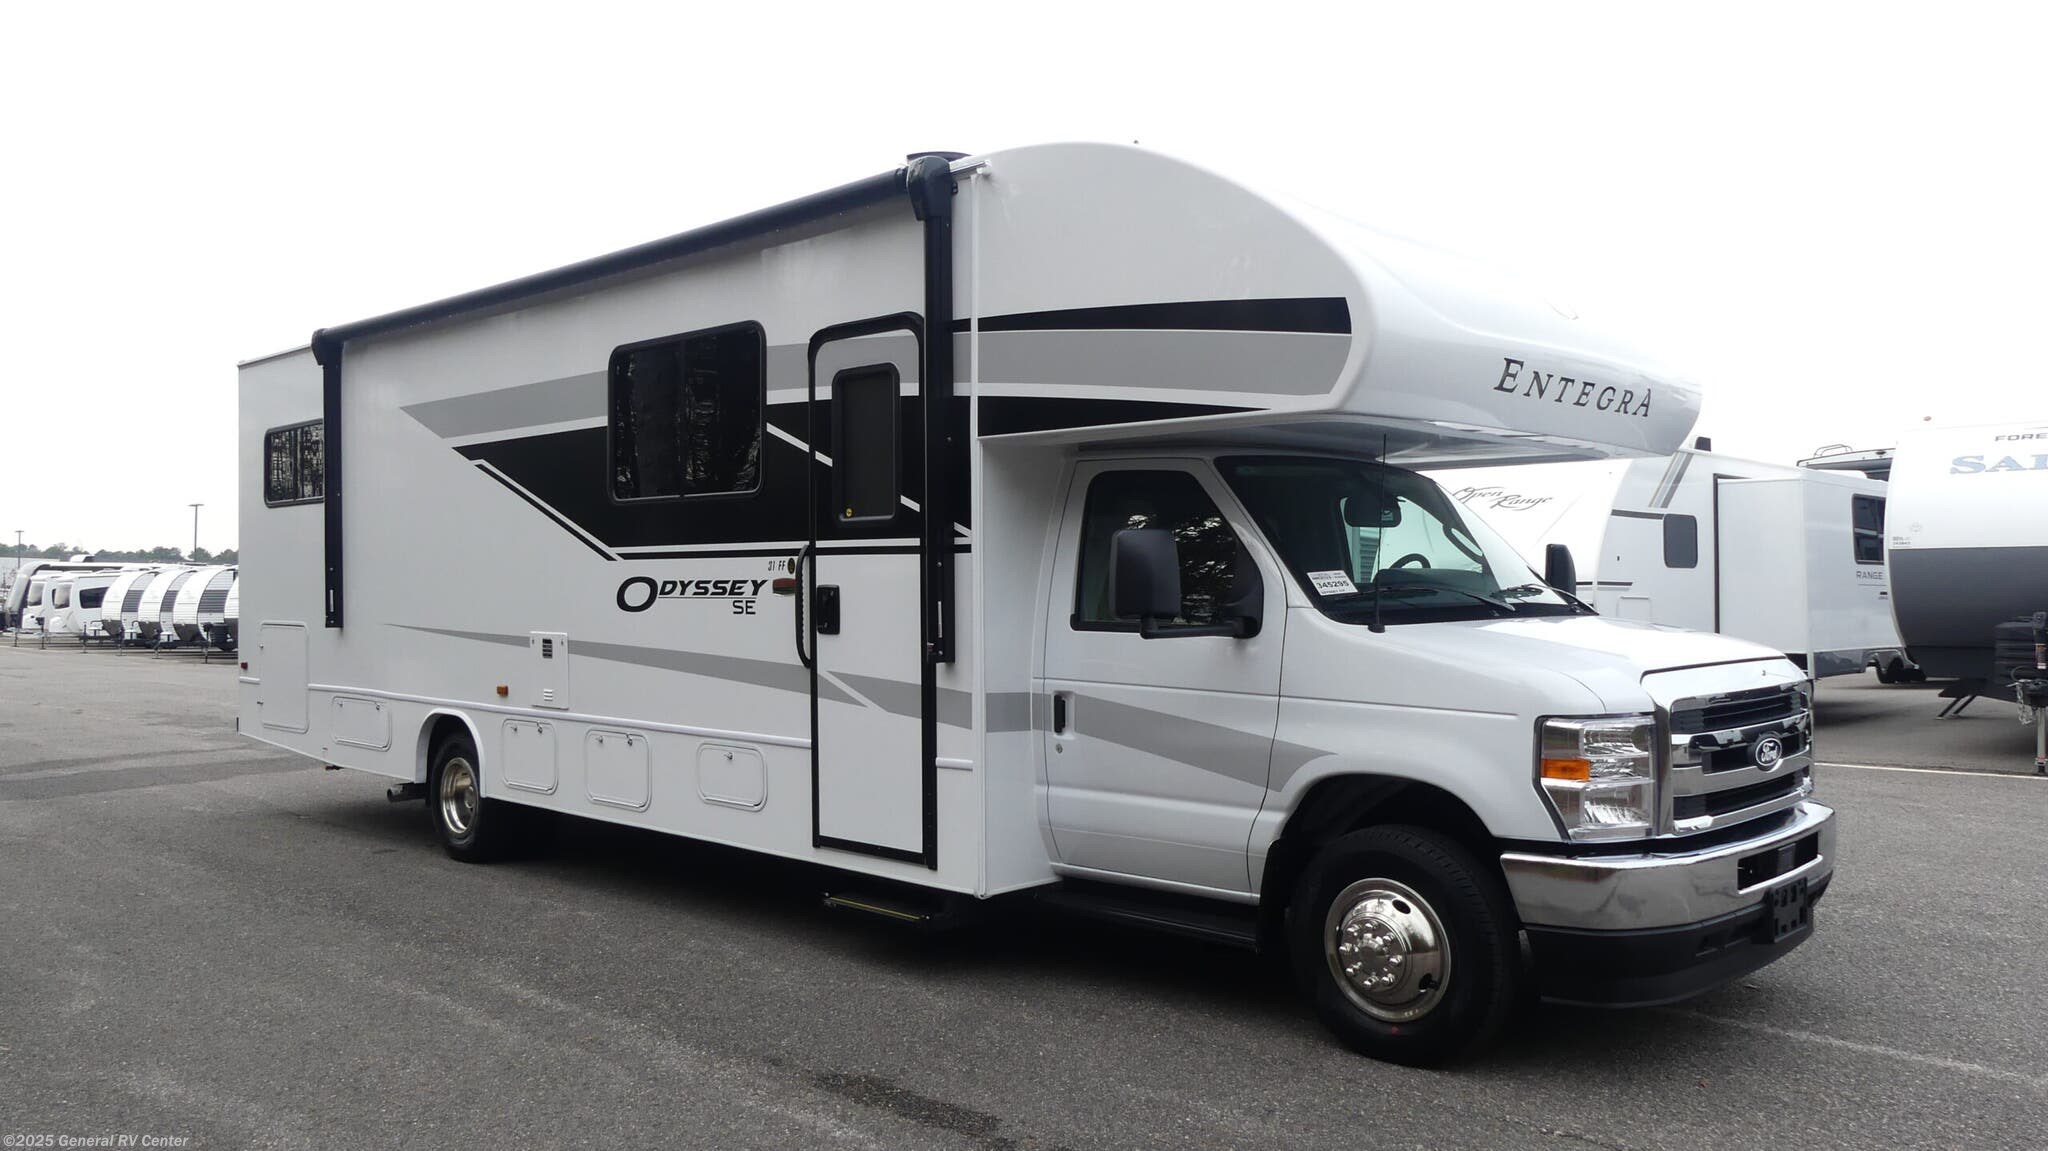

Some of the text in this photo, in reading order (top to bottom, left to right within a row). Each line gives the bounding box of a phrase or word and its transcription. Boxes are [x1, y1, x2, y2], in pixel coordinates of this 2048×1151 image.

[1493, 357, 1652, 418] ENTEGRA
[1452, 486, 1504, 505] Open
[1489, 494, 1554, 511] Range
[1856, 570, 1884, 580] RANGE
[616, 576, 768, 613] ODYSSEY
[732, 600, 756, 615] SE
